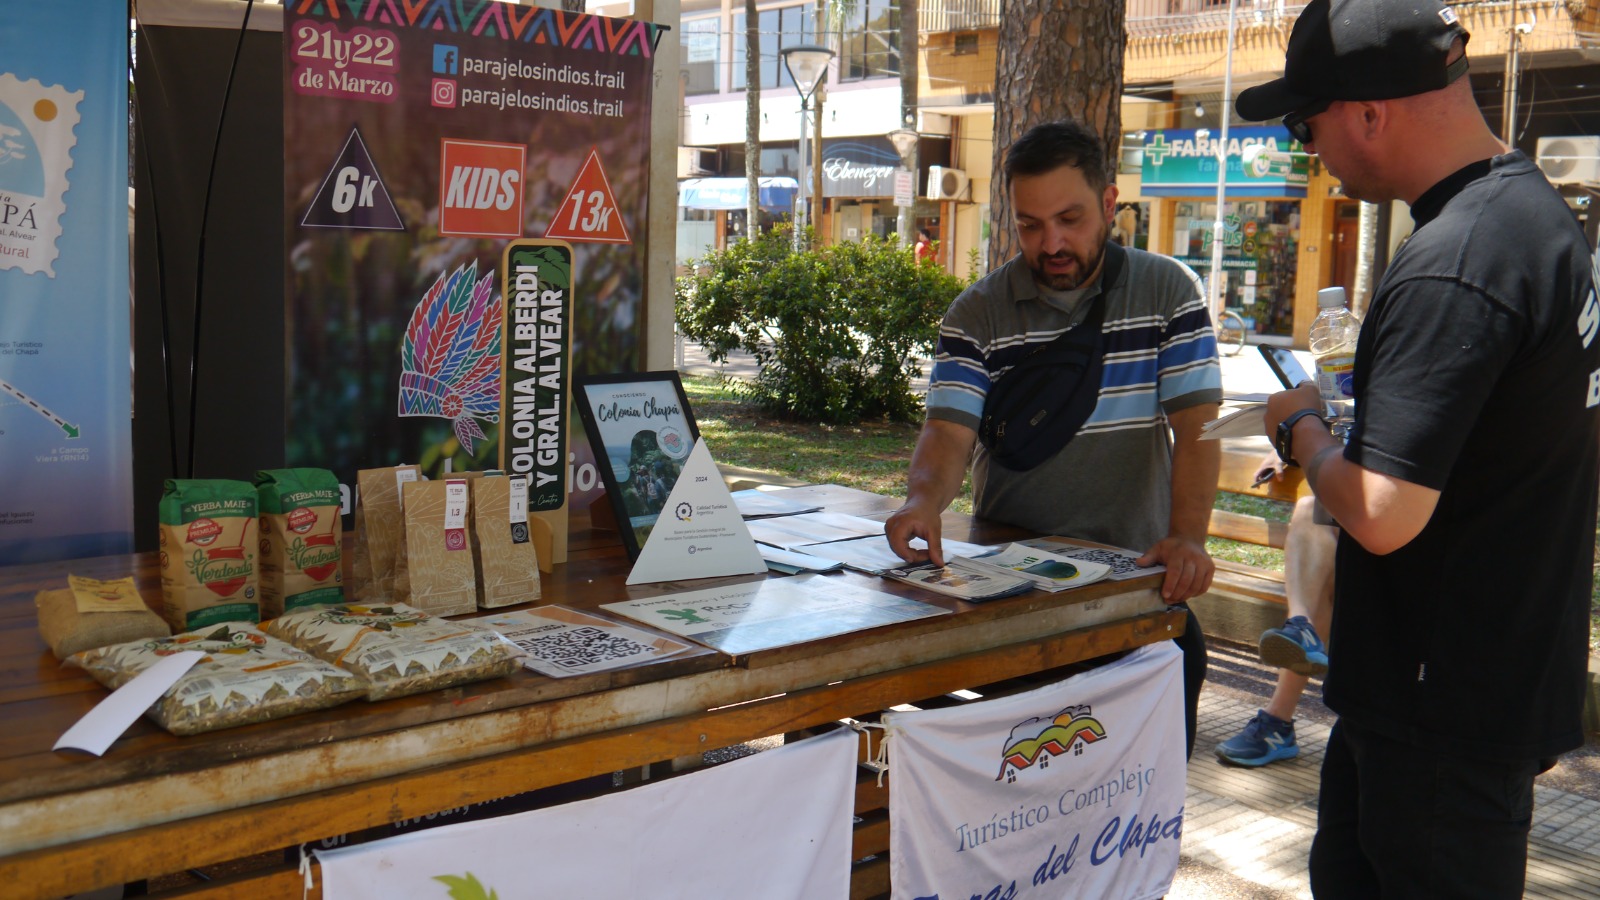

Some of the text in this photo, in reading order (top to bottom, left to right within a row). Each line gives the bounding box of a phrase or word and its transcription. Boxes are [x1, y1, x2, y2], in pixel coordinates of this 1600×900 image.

[298, 67, 393, 96] de Marzo
[462, 57, 625, 90] parajelosindios.trail
[461, 88, 624, 118] parajelosindios.trail
[823, 157, 894, 188] Ebenezer
[445, 166, 519, 212] KIDS
[9, 230, 37, 241] Alvear
[1202, 230, 1243, 252] pus
[513, 265, 539, 374] ALBERDI
[536, 289, 563, 488] Y GRAL. ALVEAR
[598, 397, 680, 422] Colonia Chapá
[191, 500, 247, 513] YERBA MATE
[290, 492, 315, 502] YERBA
[315, 490, 334, 498] MATE
[451, 508, 460, 517] 1.3
[955, 763, 1156, 853] Turístico Complejo
[1032, 834, 1080, 887] del
